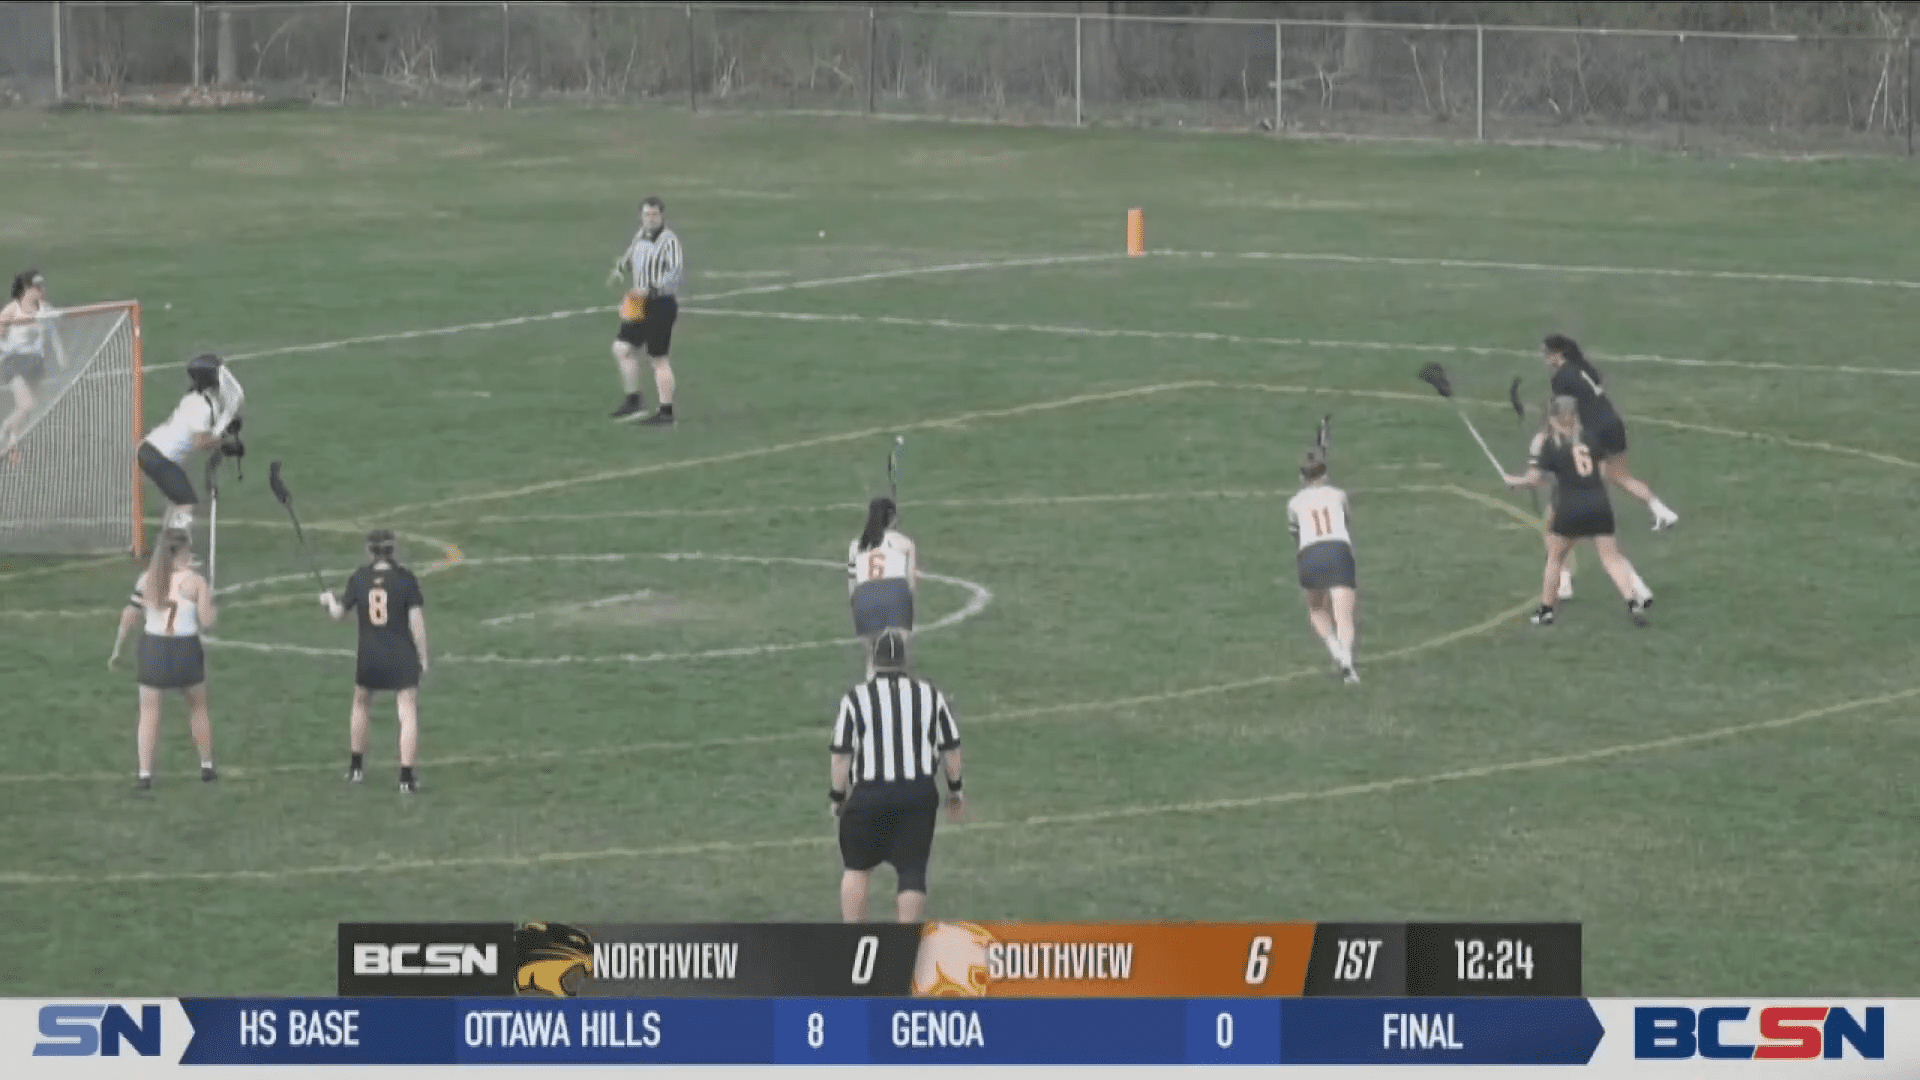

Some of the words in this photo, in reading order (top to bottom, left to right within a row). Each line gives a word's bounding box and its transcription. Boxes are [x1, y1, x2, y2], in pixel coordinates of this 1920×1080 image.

[1572, 443, 1594, 477] 6
[1311, 505, 1332, 537] 11
[868, 552, 886, 580] 6
[164, 599, 178, 635] 7
[368, 588, 386, 626] 8
